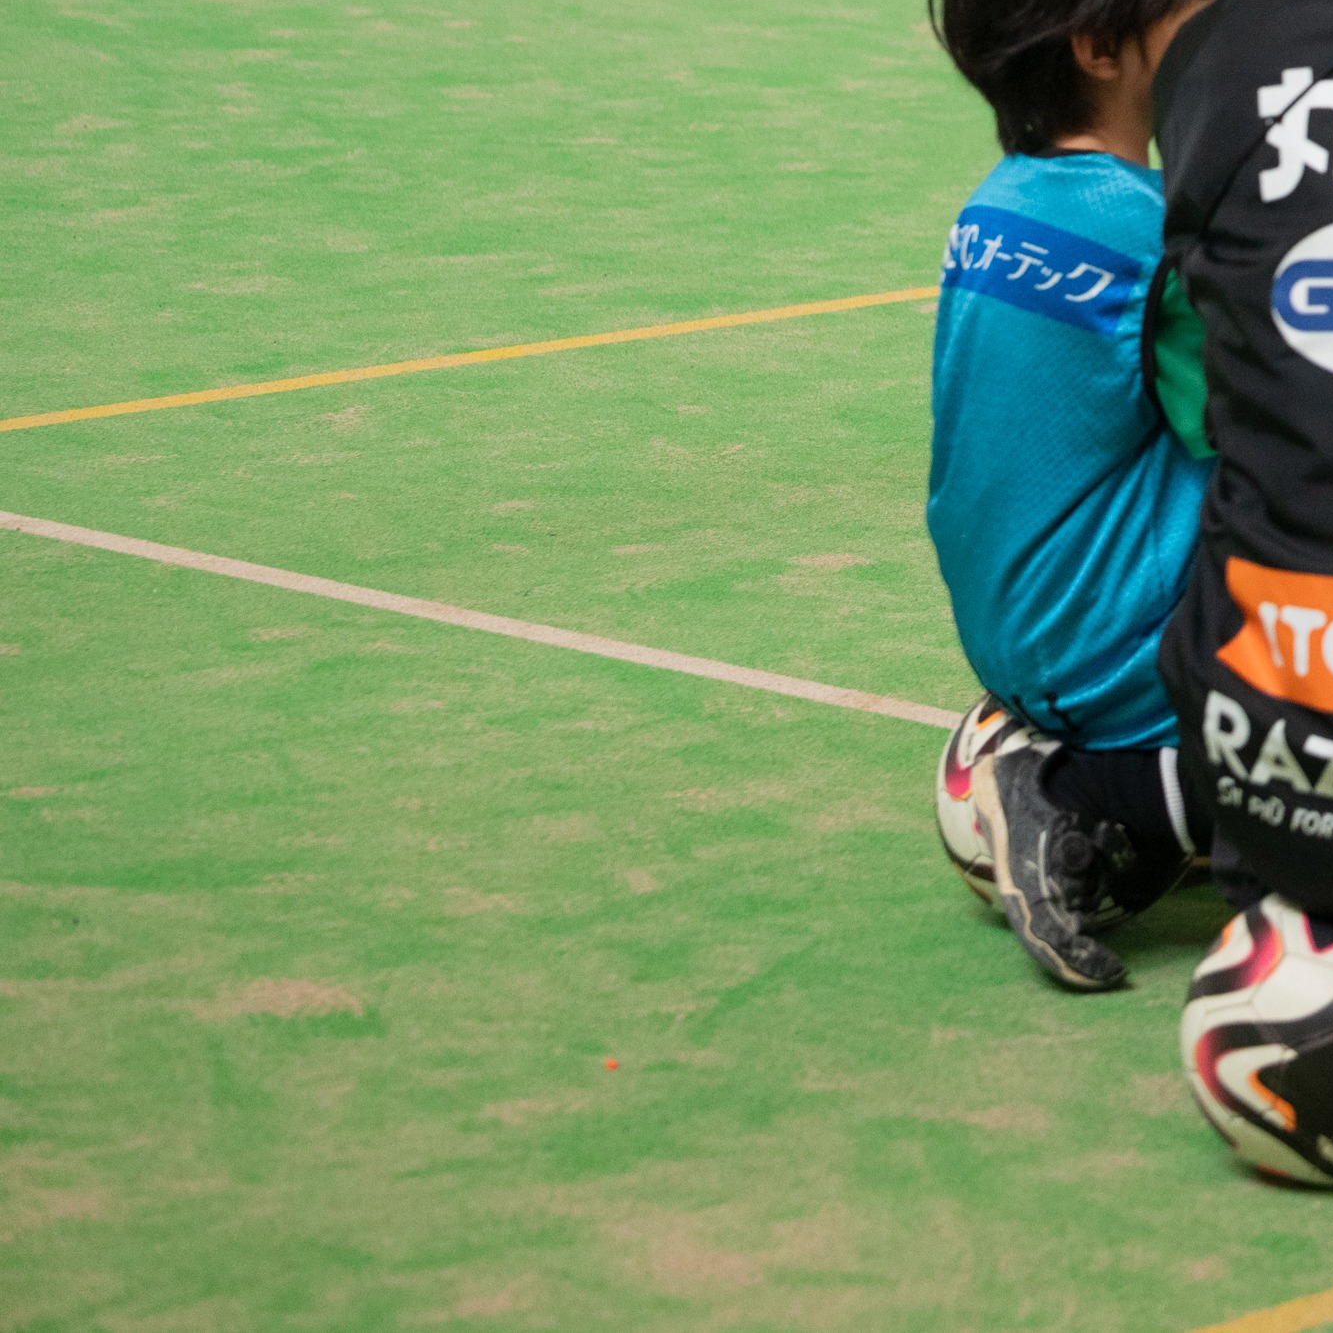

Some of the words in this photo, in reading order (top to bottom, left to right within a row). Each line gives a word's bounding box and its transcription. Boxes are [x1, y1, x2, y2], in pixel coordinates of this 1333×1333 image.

[973, 234, 1115, 302] オーテック
